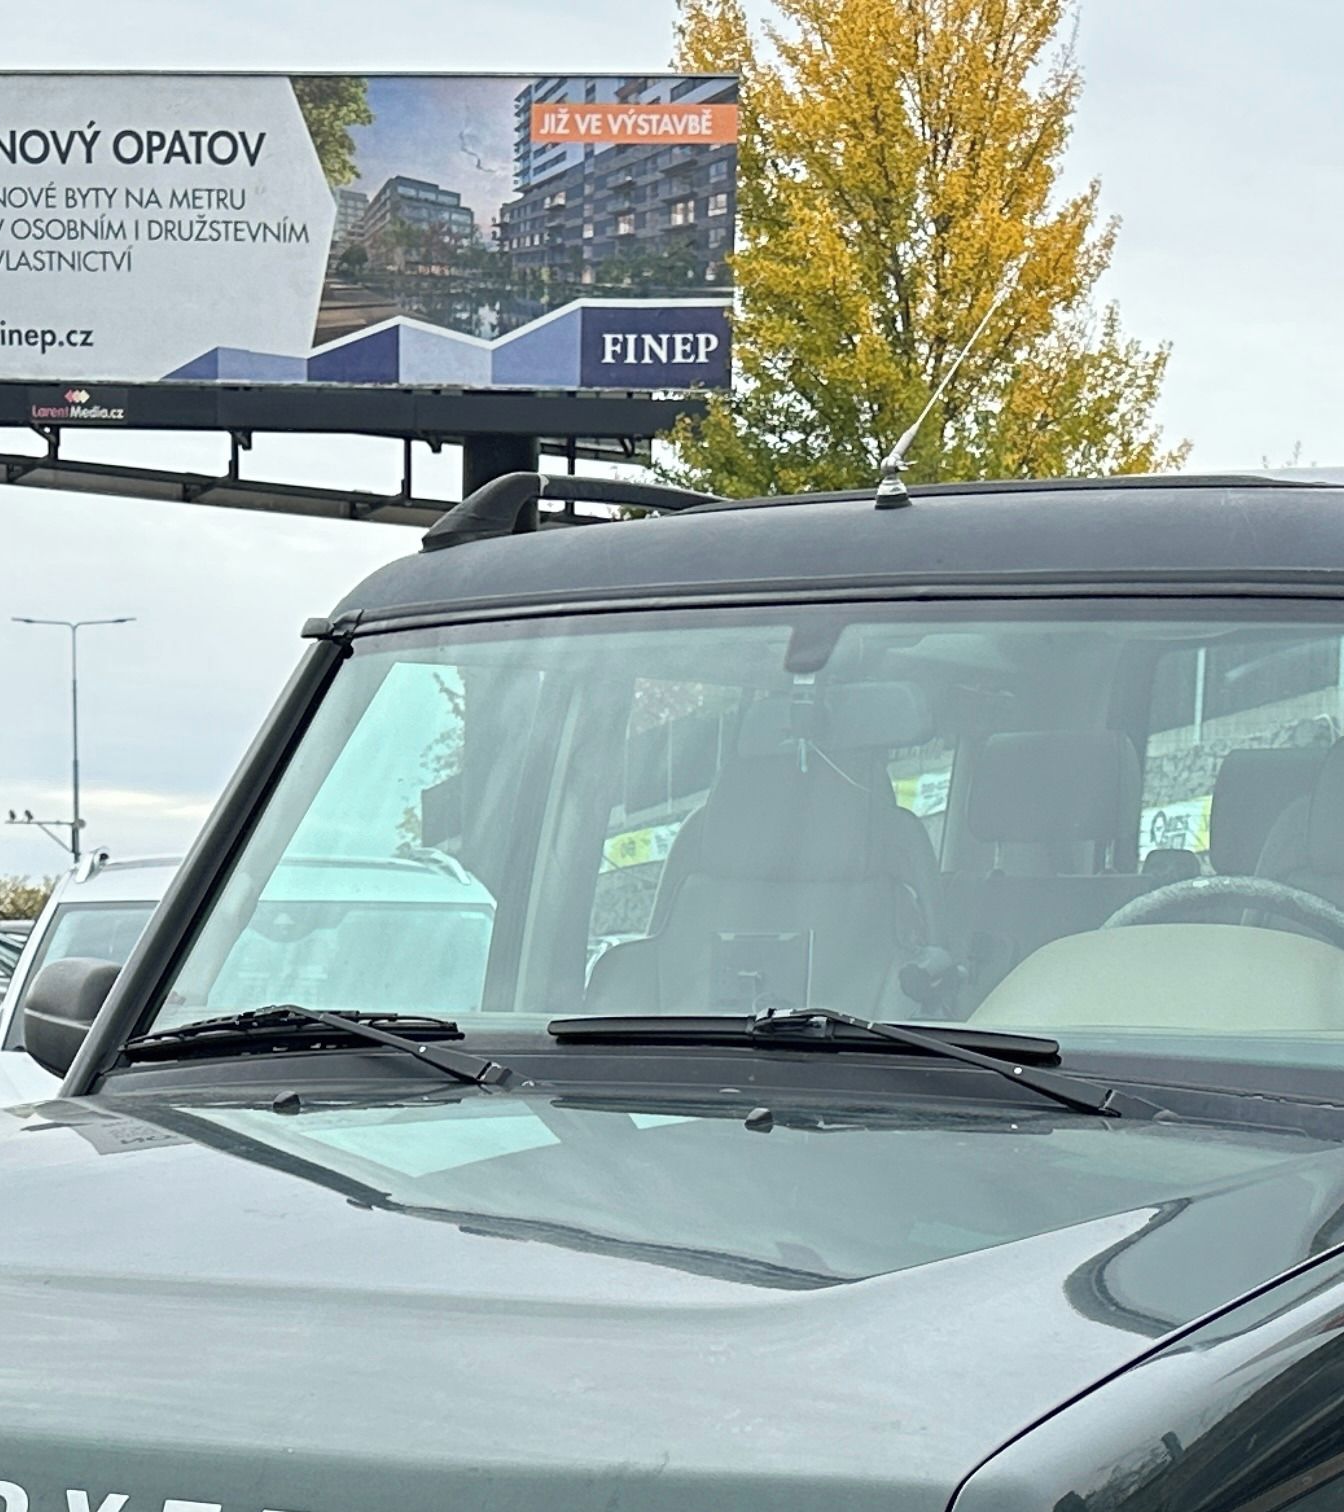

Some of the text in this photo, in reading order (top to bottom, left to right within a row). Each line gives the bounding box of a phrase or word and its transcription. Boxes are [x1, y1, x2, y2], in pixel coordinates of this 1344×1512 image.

[539, 108, 713, 136] JIŽ VE VÝSTAVBĚ
[112, 129, 266, 167] OPATOV
[65, 187, 118, 209] BYTY
[125, 188, 162, 210] NA
[169, 188, 246, 211] METRU
[10, 213, 127, 241] OSOBNÍM
[134, 220, 140, 241] I
[147, 213, 310, 244] DRUŽSTEVNÍM
[600, 333, 719, 365] FINEP
